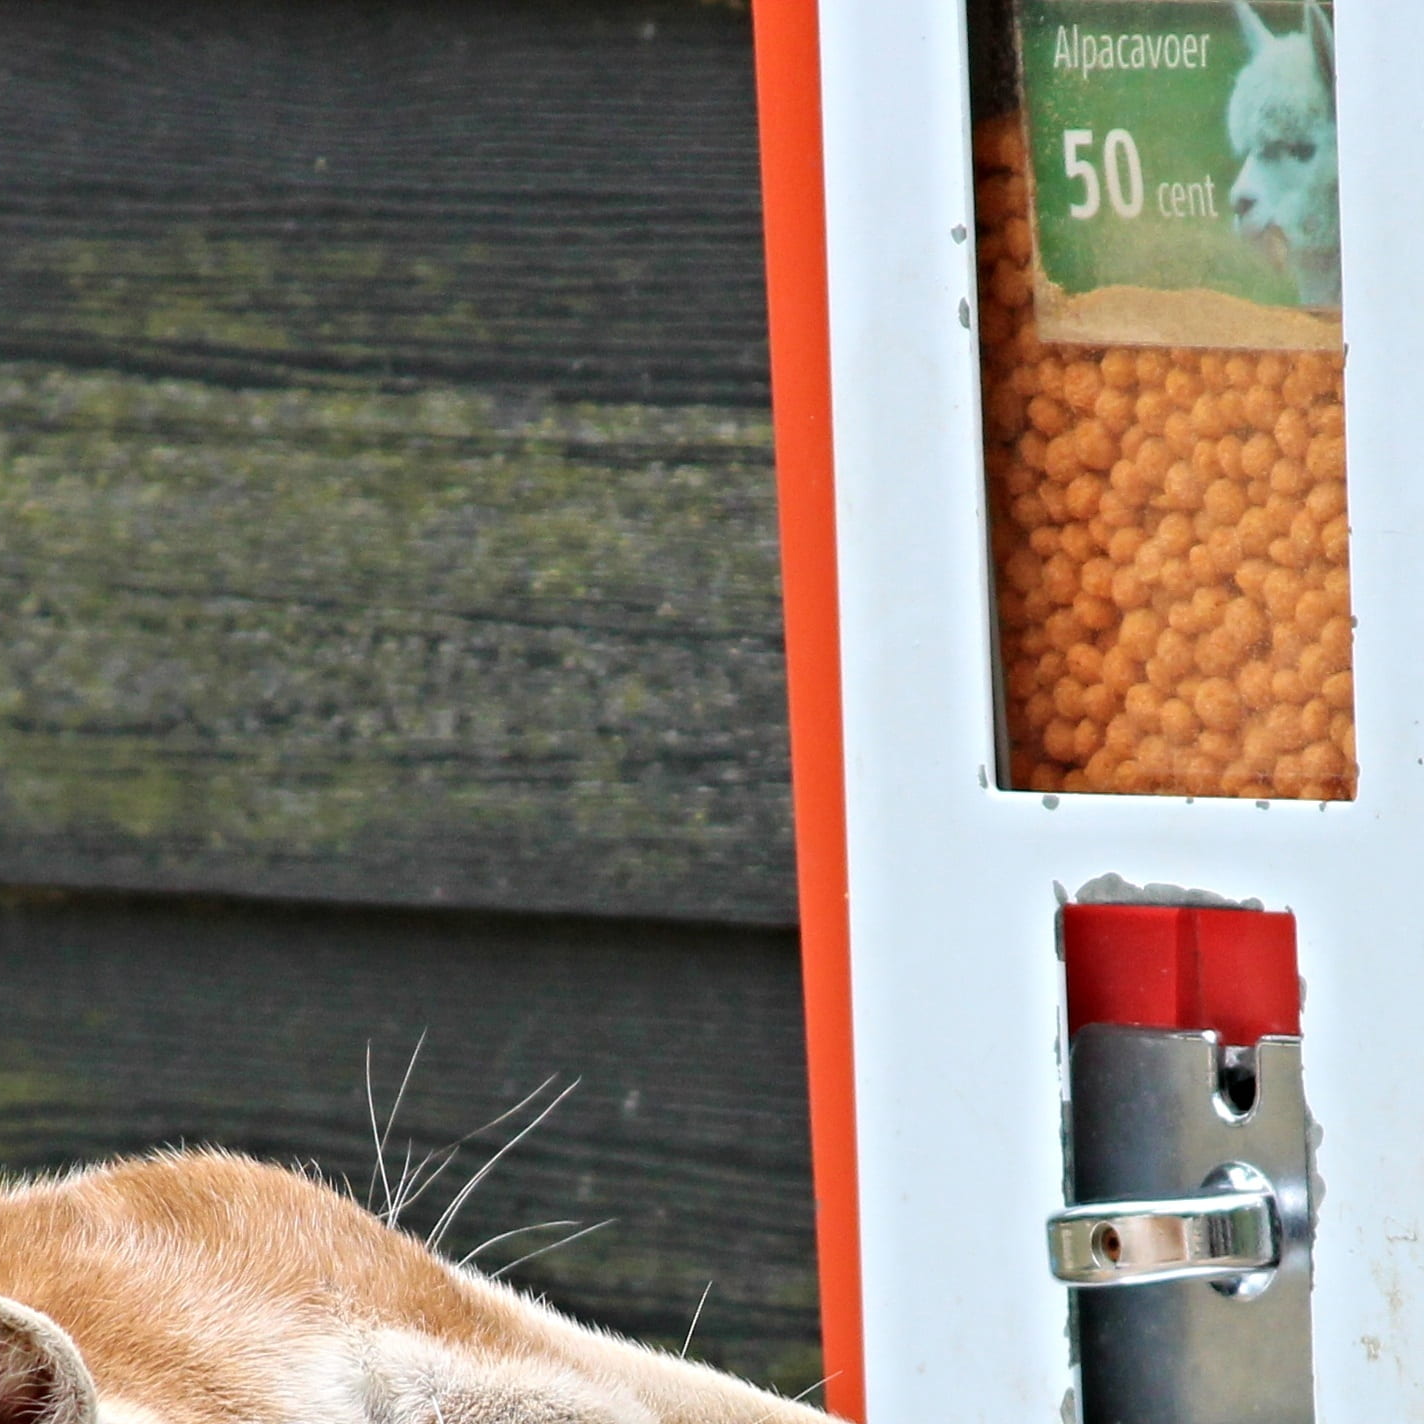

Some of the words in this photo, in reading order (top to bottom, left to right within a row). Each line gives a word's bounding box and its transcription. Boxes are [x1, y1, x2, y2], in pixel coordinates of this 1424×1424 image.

[1054, 25, 1210, 79] Alpacavoer
[1063, 128, 1143, 220] 50
[1157, 175, 1218, 218] cent
